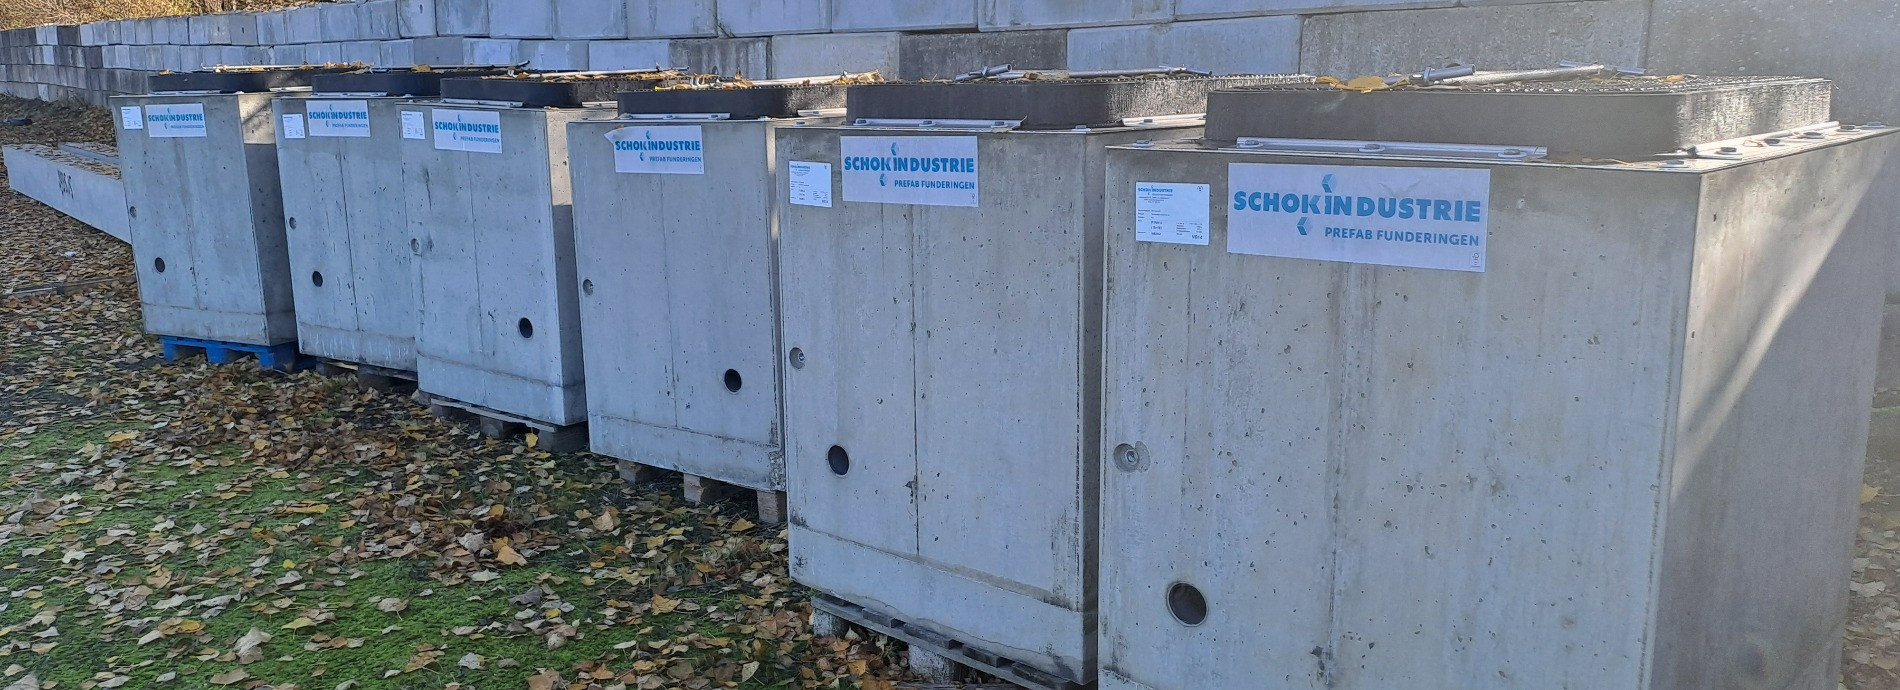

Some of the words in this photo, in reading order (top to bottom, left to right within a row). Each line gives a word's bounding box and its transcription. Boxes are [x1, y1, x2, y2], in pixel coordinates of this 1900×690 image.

[148, 113, 203, 121] SCHOKINDUSTRIE
[434, 121, 499, 133] SCHOKINDUSTRIE
[615, 141, 700, 151] SCHOKINDUSTRIE
[844, 156, 974, 173] SCHOKINDUSTRIE
[894, 179, 920, 188] PREFAB
[921, 180, 975, 190] FUNDERINGEN
[1233, 191, 1481, 222] SCHOKINDUSTRIE
[1324, 226, 1373, 240] PREFAB
[1376, 229, 1479, 247] FUNDERINGEN
